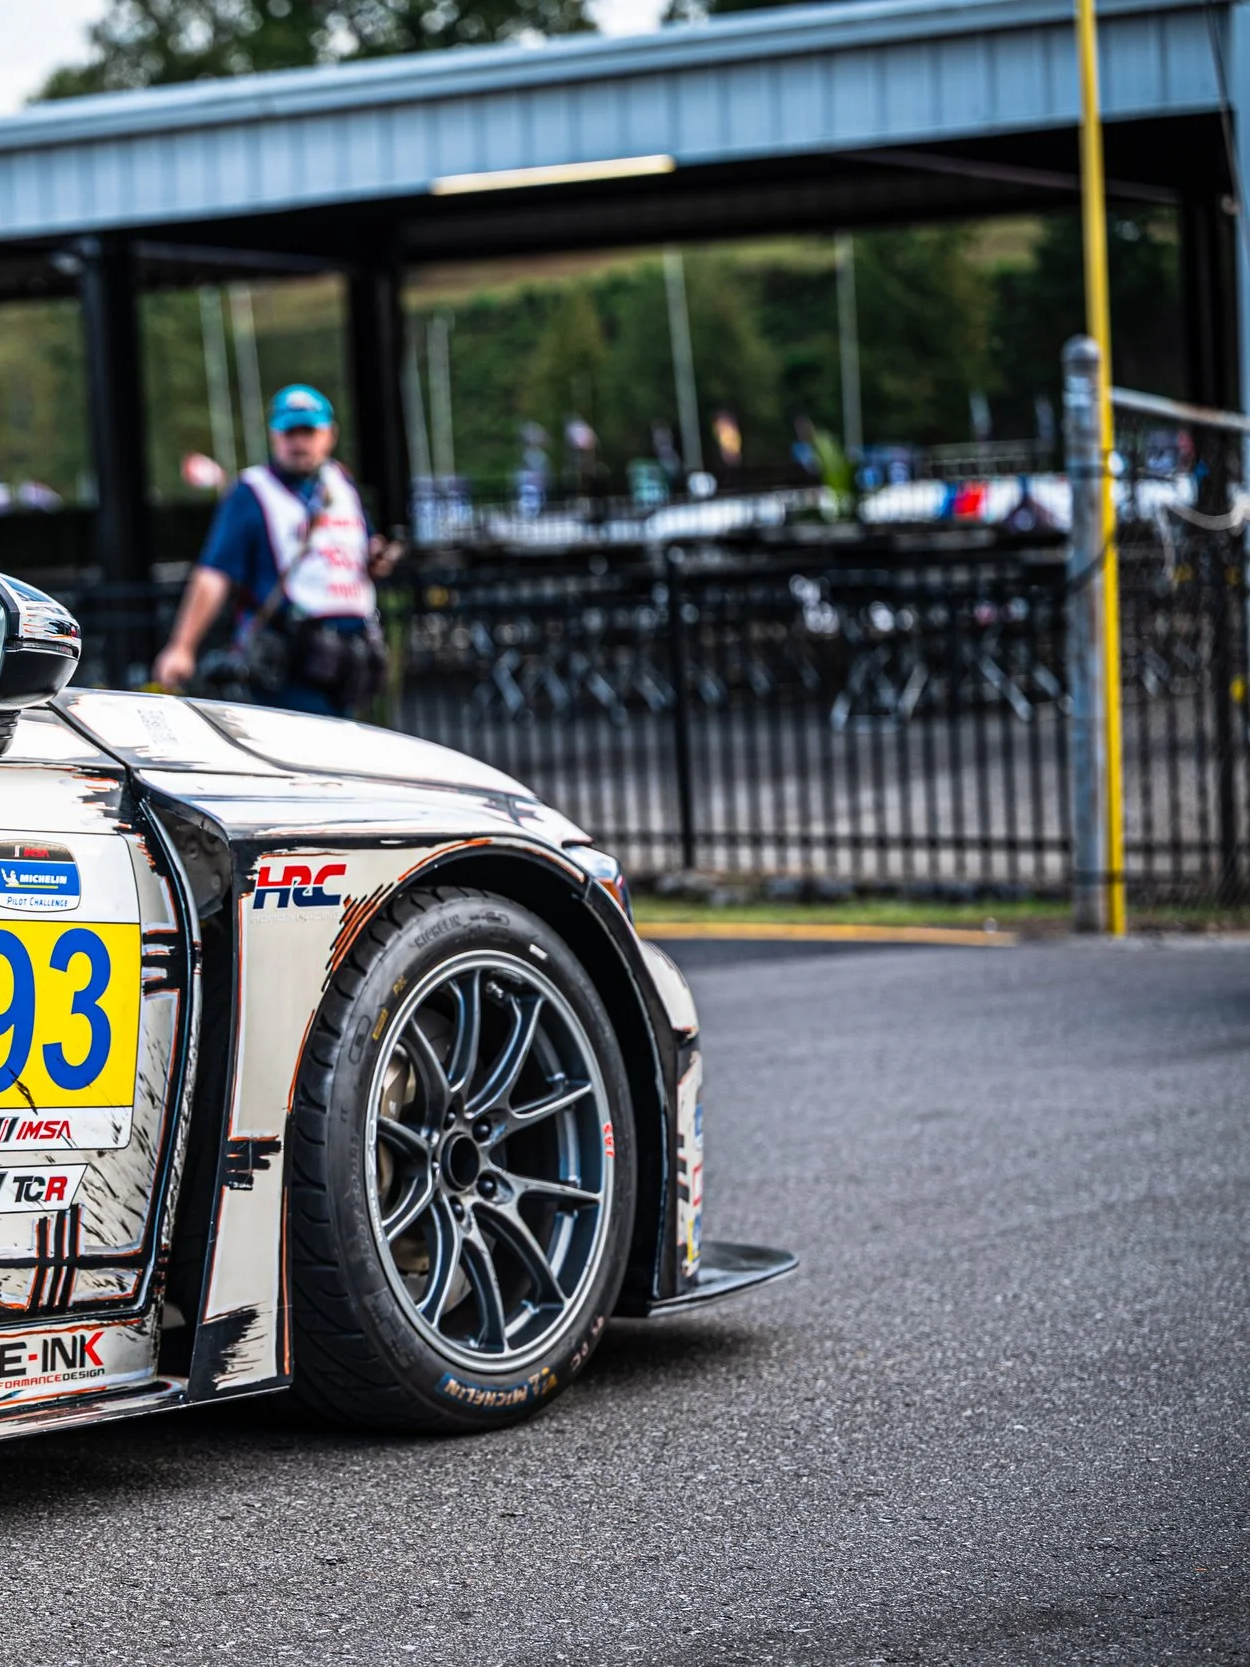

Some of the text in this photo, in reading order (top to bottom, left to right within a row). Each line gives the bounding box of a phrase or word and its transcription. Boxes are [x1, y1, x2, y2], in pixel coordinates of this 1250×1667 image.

[19, 874, 68, 885] MICHELIN
[253, 864, 347, 910] HRC
[7, 896, 69, 908] PILOT CHALLENGE
[15, 1120, 72, 1140] IMSA
[12, 1175, 69, 1203] TCR
[443, 1377, 528, 1407] MICHELIN
